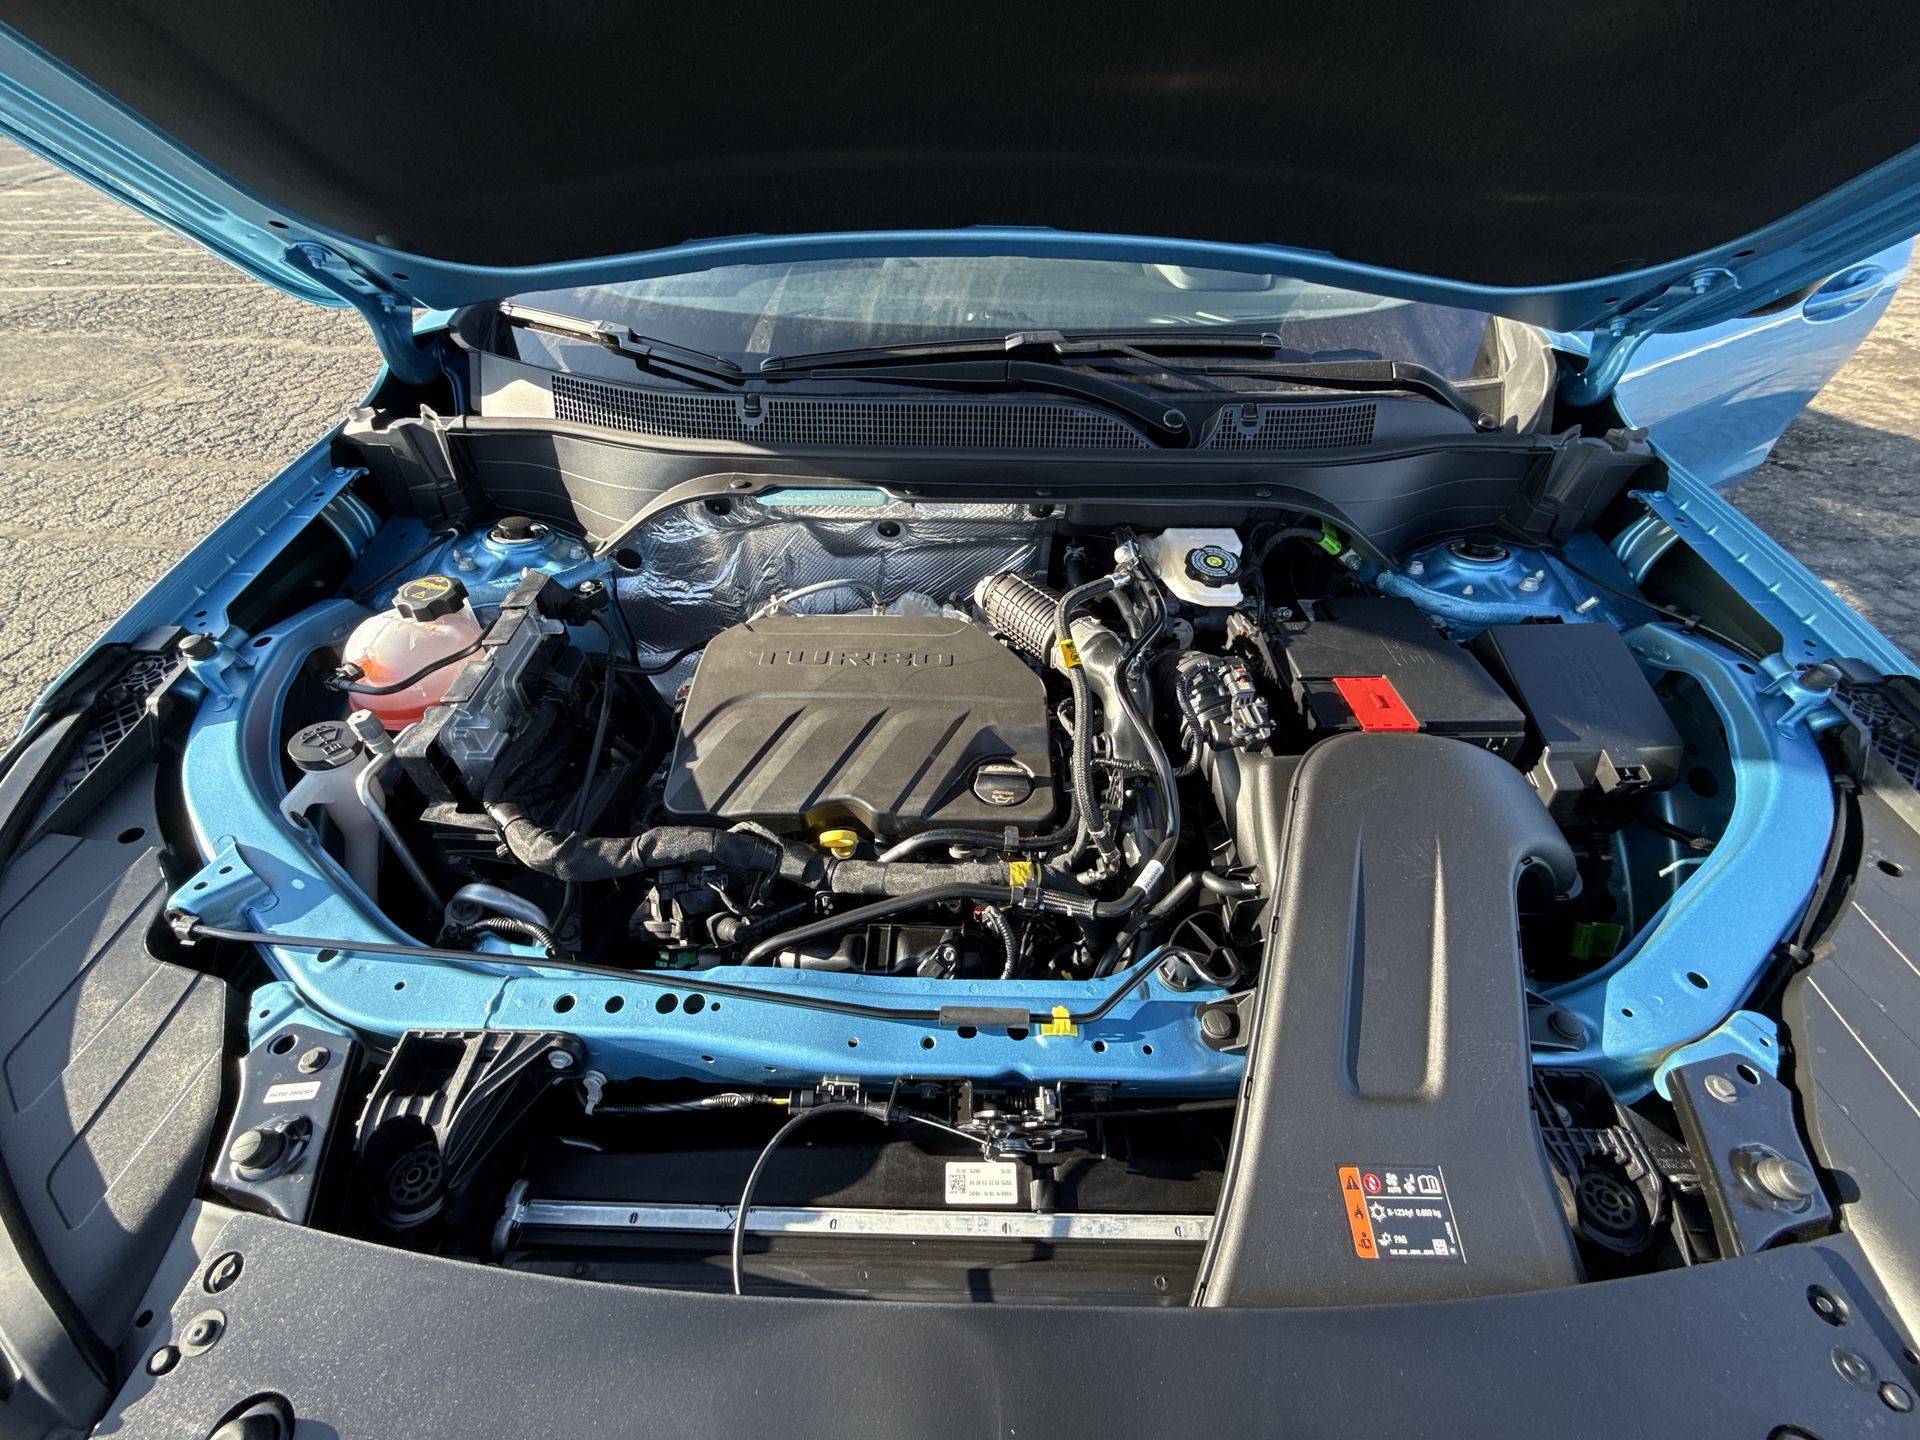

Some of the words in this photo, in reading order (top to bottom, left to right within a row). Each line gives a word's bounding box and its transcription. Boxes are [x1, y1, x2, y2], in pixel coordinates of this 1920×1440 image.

[749, 650, 955, 667] TURBO
[984, 764, 1024, 773] ACDelco
[1387, 1186, 1401, 1194] AUTO
[1386, 1208, 1414, 1218] R-1234yf
[1432, 1208, 1442, 1218] kg
[1393, 1234, 1408, 1245] PAG
